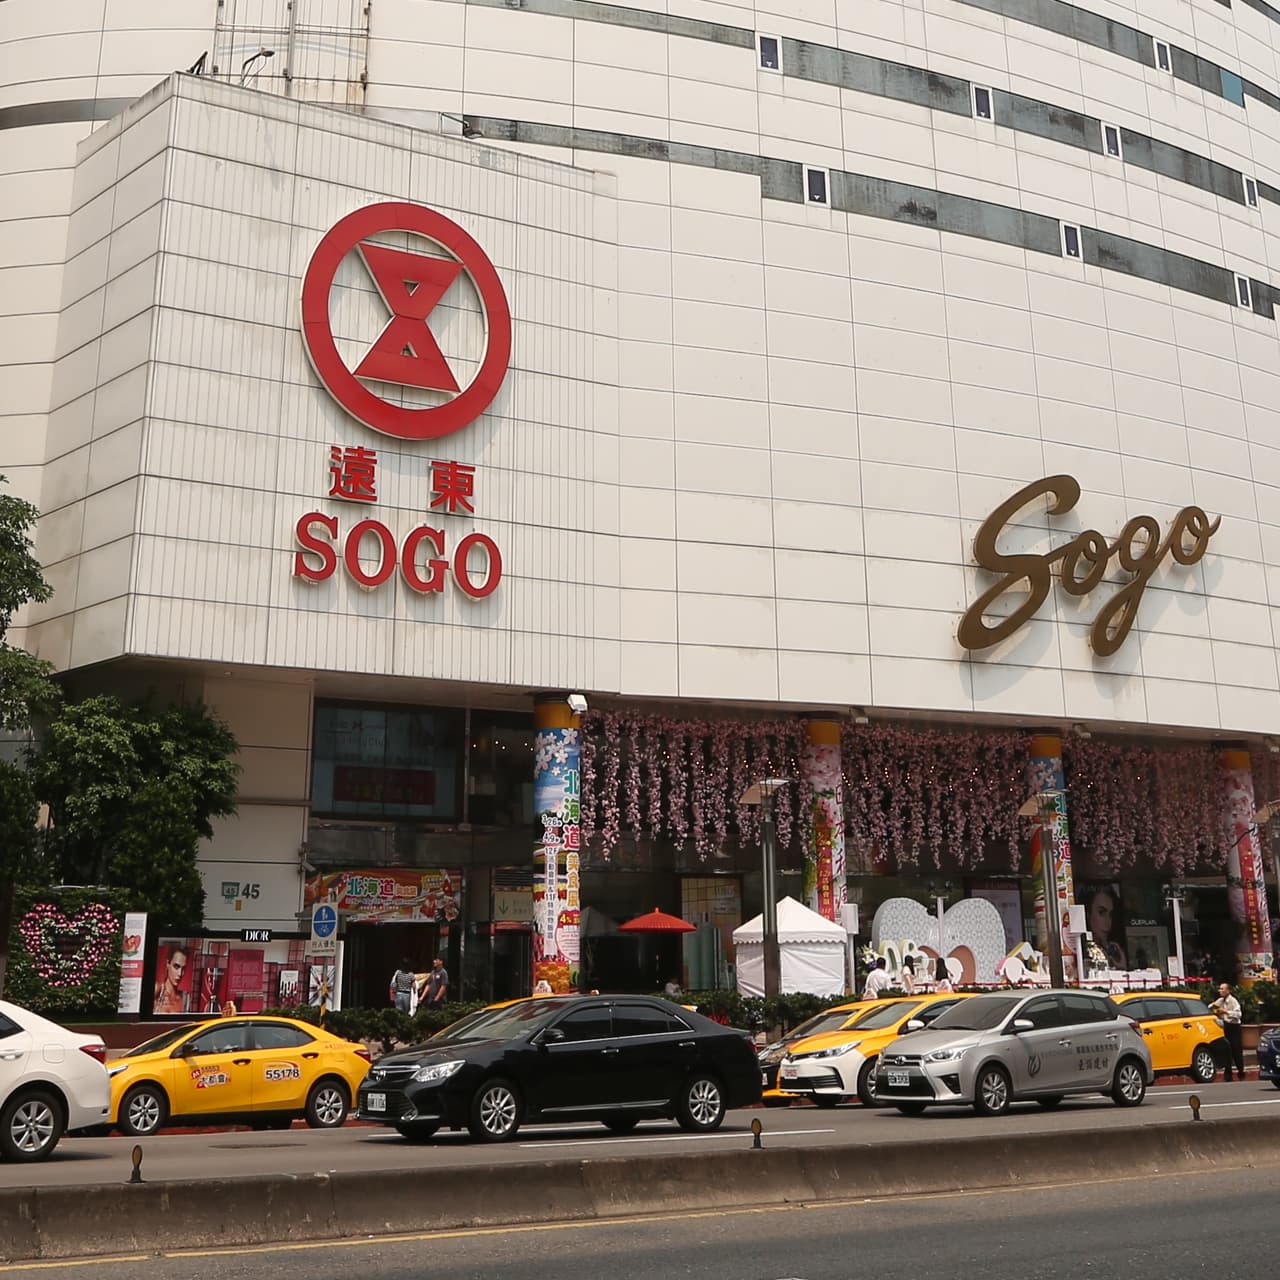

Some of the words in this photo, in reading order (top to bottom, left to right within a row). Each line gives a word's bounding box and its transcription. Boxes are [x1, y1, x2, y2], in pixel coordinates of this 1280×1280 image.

[328, 446, 477, 513] 遠東
[293, 510, 503, 599] SOGO
[957, 474, 1222, 657] Sogo
[242, 883, 261, 900] 45
[245, 929, 270, 941] DIOR
[265, 1069, 300, 1081] 55178
